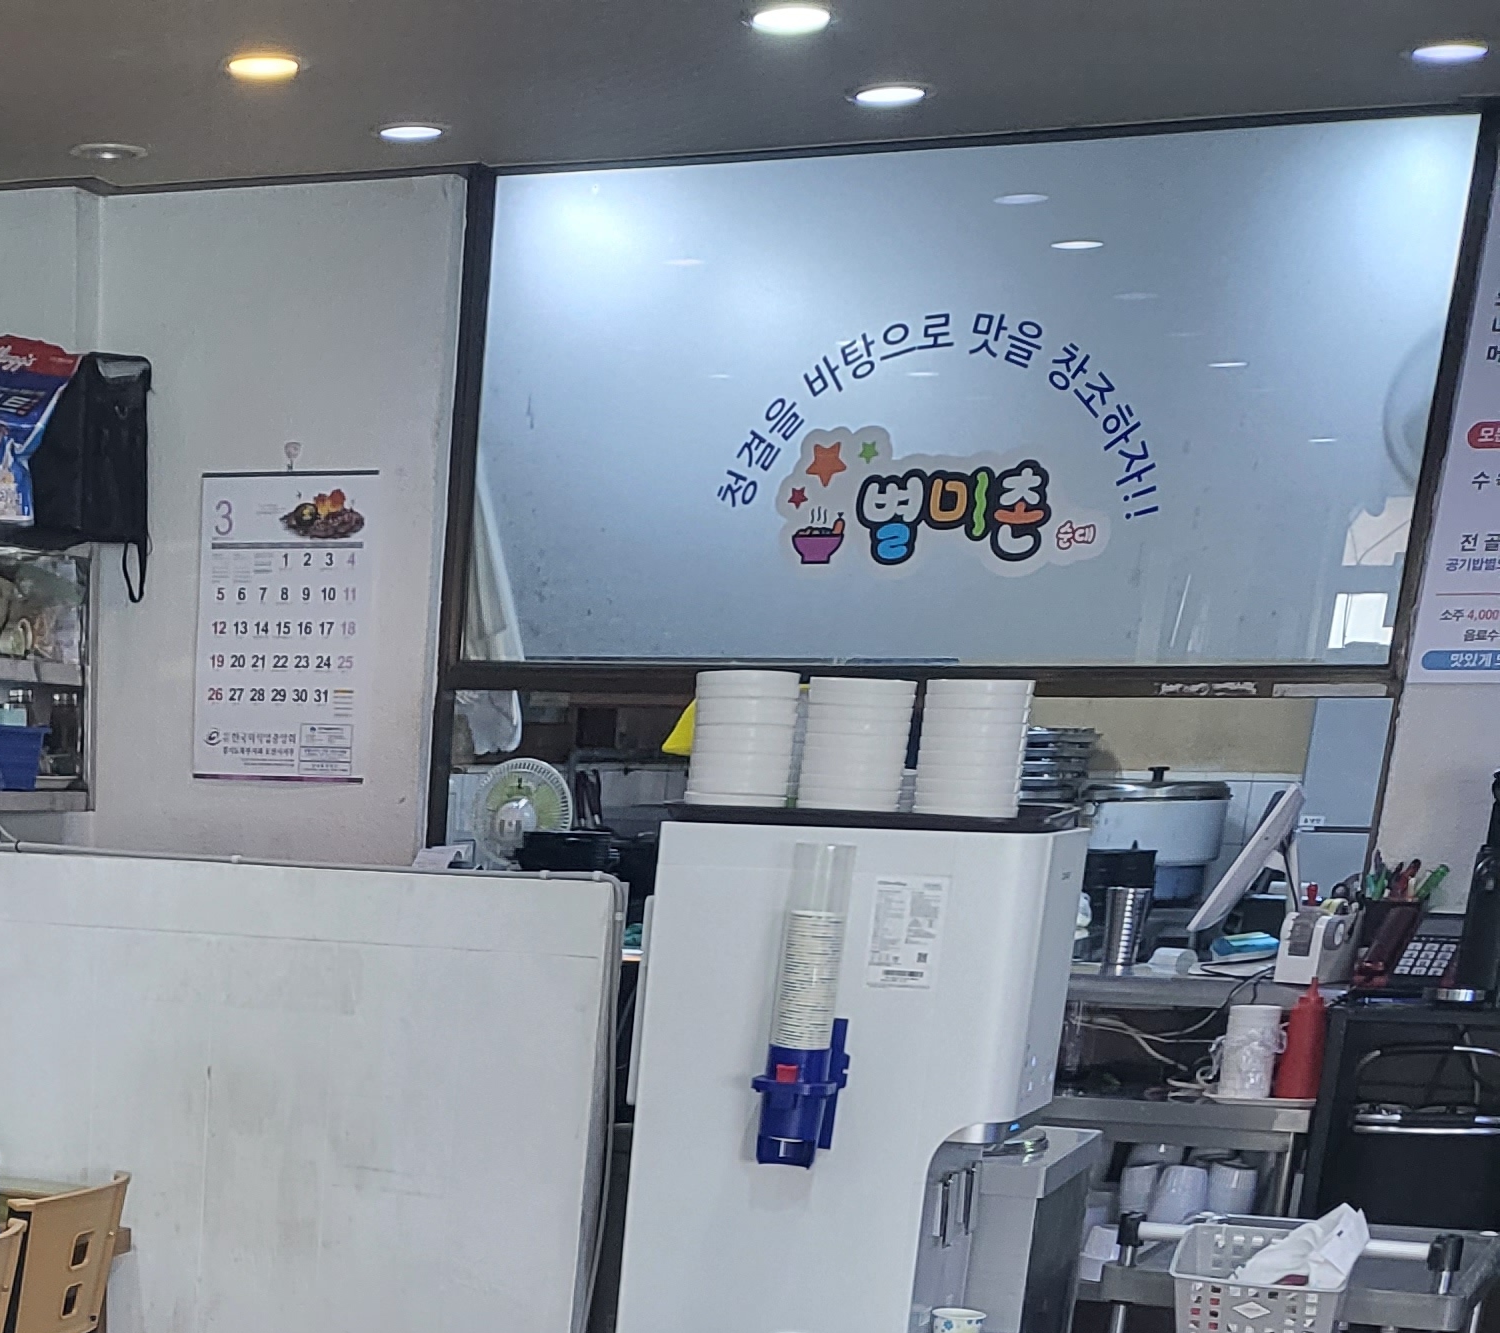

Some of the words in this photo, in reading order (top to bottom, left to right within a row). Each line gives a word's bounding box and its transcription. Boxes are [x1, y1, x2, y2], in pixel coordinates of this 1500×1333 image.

[717, 397, 805, 509] 청결을
[803, 313, 955, 398] 바탕으로
[968, 312, 1043, 369] 맛을
[1048, 342, 1160, 522] 창조하자!!
[215, 500, 233, 536] 3
[857, 460, 1051, 564] 별미촌
[282, 554, 288, 566] 1
[304, 554, 311, 566] 2
[325, 554, 333, 566] 3
[1445, 556, 1500, 572] 공기밥별
[216, 588, 224, 601] 5
[238, 588, 246, 601] 6
[259, 588, 266, 601] 7
[280, 588, 289, 601] 8
[302, 588, 310, 601] 9
[321, 588, 336, 601] 10
[1439, 609, 1464, 621] 소주
[1467, 609, 1500, 622] 4,000
[212, 622, 226, 634] 12
[234, 622, 248, 635] 13
[254, 622, 269, 635] 14
[276, 622, 290, 635] 15
[298, 622, 312, 635] 16
[319, 622, 333, 635] 17
[210, 655, 224, 668] 19
[230, 655, 245, 668] 20
[251, 655, 265, 668] 21
[273, 655, 288, 668] 22
[294, 655, 309, 669] 23
[316, 655, 331, 669] 24
[1450, 653, 1491, 668] 맛있게
[208, 688, 223, 701] 26
[229, 688, 244, 701] 27
[250, 688, 265, 701] 28
[271, 689, 286, 701] 29
[292, 689, 307, 702] 30
[314, 689, 328, 702] 31
